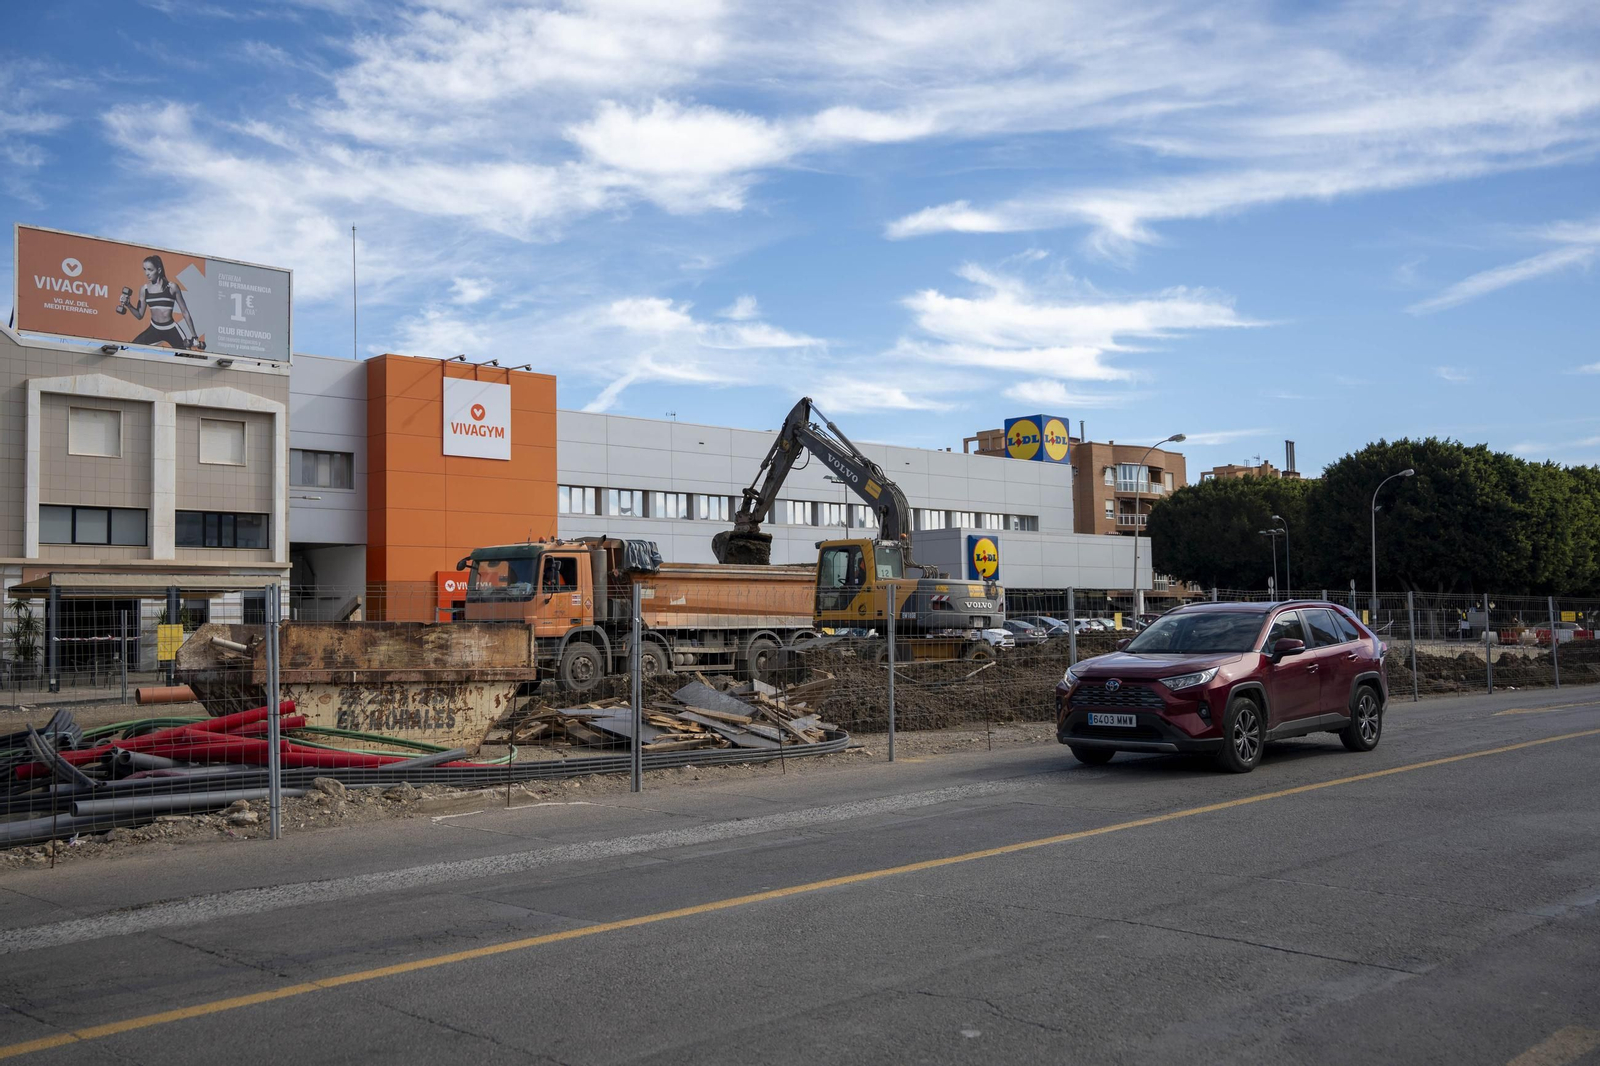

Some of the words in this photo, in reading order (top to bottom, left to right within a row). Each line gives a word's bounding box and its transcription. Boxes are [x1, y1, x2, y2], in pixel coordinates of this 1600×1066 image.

[34, 275, 108, 298] VIVAGYM
[230, 282, 272, 294] PERMANENCIA
[218, 326, 235, 335] CLUB
[236, 328, 271, 340] RENOVADO
[451, 422, 504, 439] VIVAGYM
[828, 453, 858, 482] VOLVO
[1094, 715, 1114, 724] 6403
